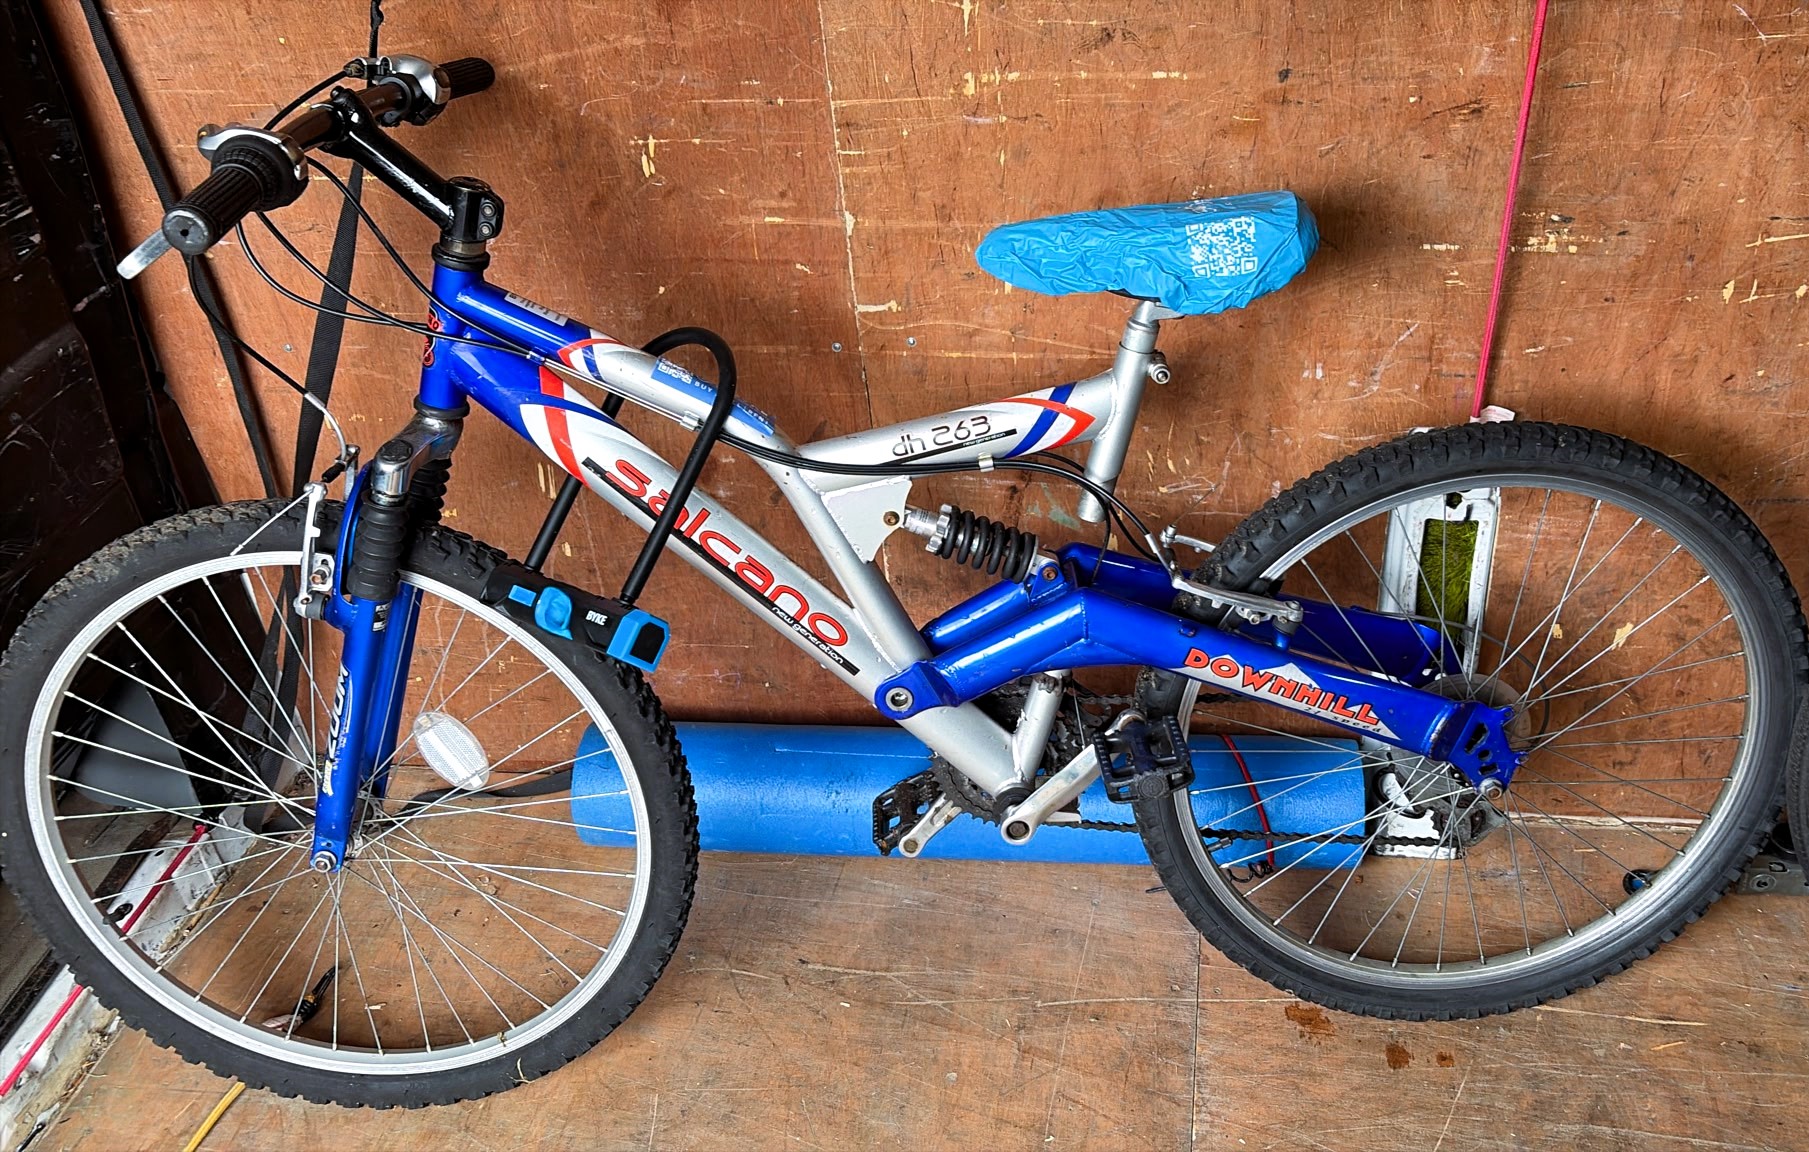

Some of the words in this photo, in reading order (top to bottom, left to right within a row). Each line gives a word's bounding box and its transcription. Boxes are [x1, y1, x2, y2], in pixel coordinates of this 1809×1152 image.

[694, 380, 714, 393] BUY
[892, 433, 926, 457] dh
[932, 415, 991, 447] 263
[585, 610, 608, 626] BYKE
[771, 606, 793, 623] new
[792, 619, 844, 664] generation
[1184, 647, 1381, 725] DOWNHILL
[1332, 715, 1382, 733] speed
